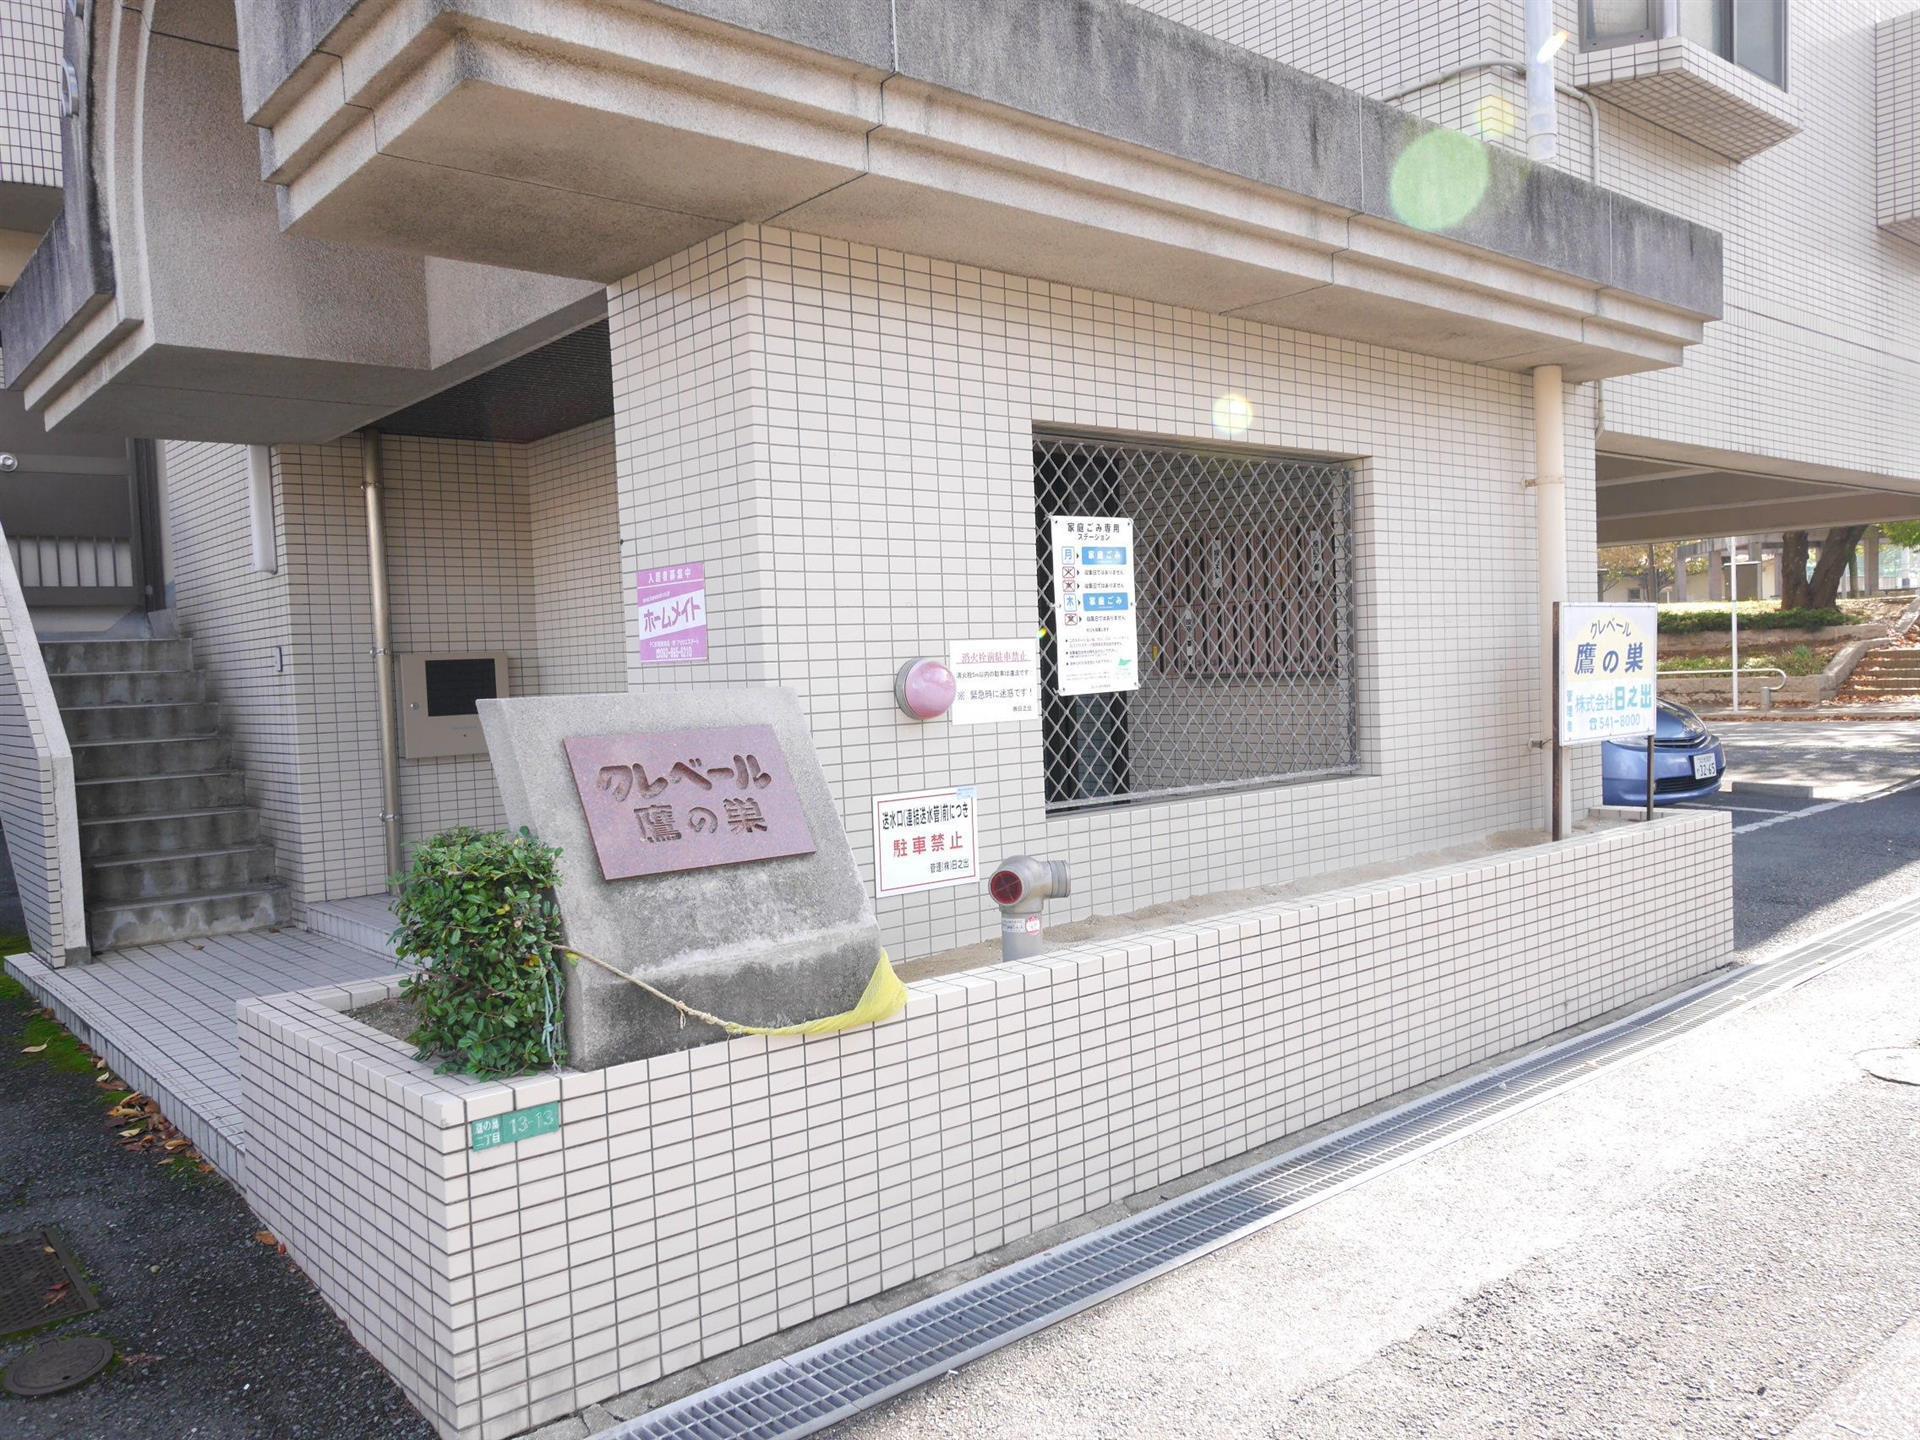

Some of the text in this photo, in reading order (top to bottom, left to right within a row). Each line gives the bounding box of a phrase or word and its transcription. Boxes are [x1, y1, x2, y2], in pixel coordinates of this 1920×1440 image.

[1067, 522, 1120, 534] 家庭ごみ専用
[1078, 533, 1110, 542] ステーション
[1064, 549, 1122, 560] 月 家庭ごみ
[1066, 596, 1122, 607] 木 家庭ごみ
[643, 596, 702, 633] ホームメイト
[1590, 617, 1632, 639] クレベール
[961, 650, 1025, 664] 消火栓前駐車禁止
[1574, 642, 1644, 675] 鷹の巣
[1576, 684, 1652, 713] 株式会社日之出
[596, 754, 773, 802] クレベール
[633, 797, 768, 844] 鷹の巣
[893, 831, 963, 858] 駐車禁止
[509, 1110, 554, 1135] 13-13
